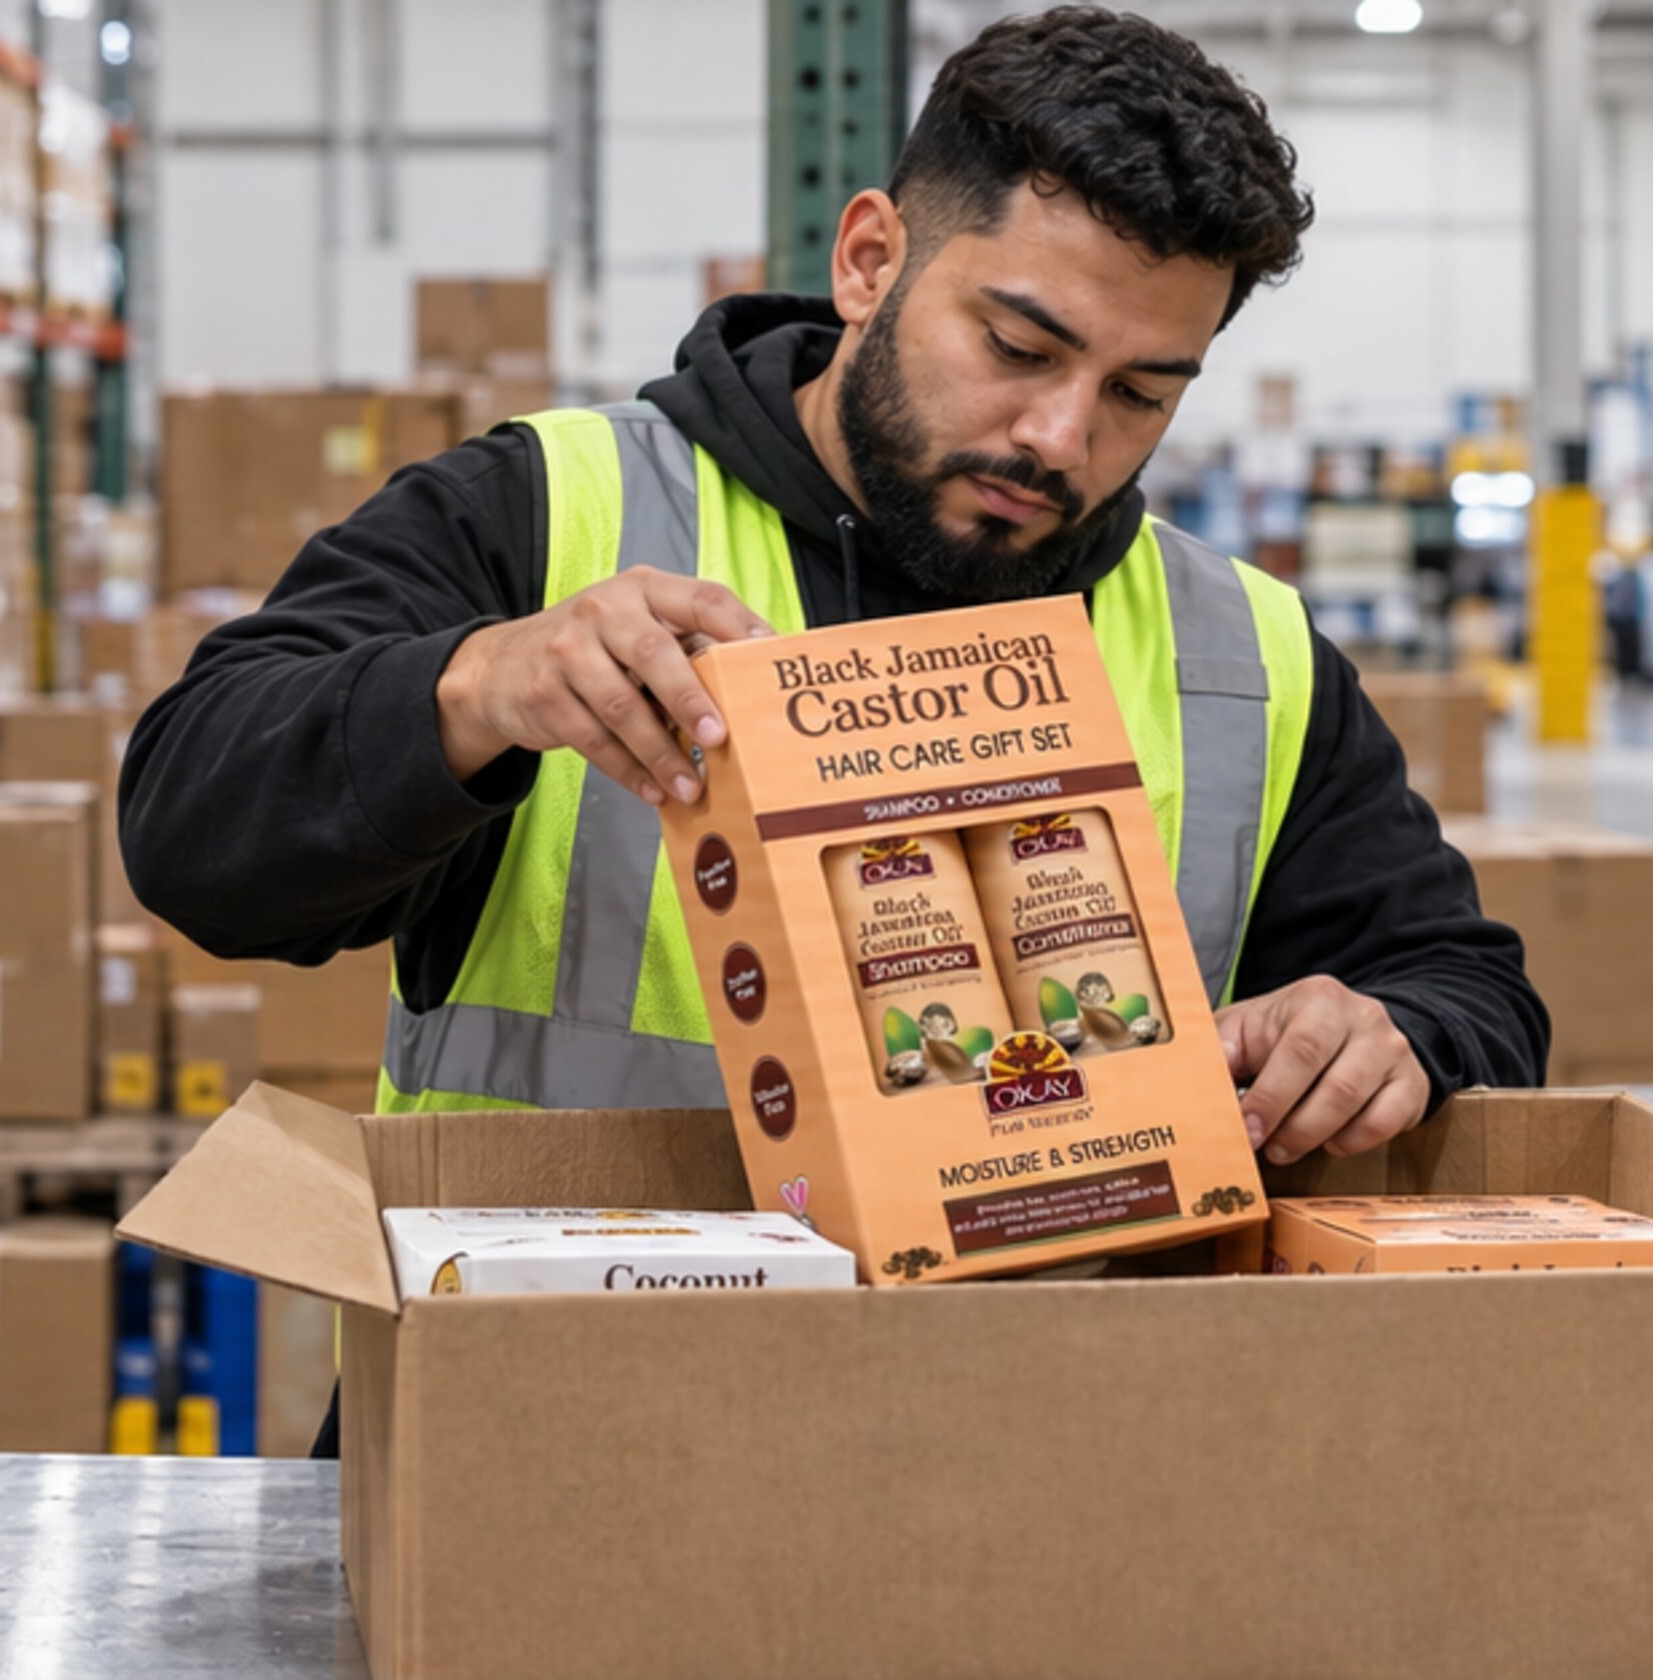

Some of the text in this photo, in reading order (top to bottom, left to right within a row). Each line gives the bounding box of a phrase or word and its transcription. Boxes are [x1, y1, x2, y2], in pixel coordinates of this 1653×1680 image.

[773, 632, 1056, 690] Black Jamaican
[786, 656, 1070, 738] Castor Oil
[816, 723, 1074, 782] HAIR CARE GIFT SET
[1050, 1148, 1065, 1168] &
